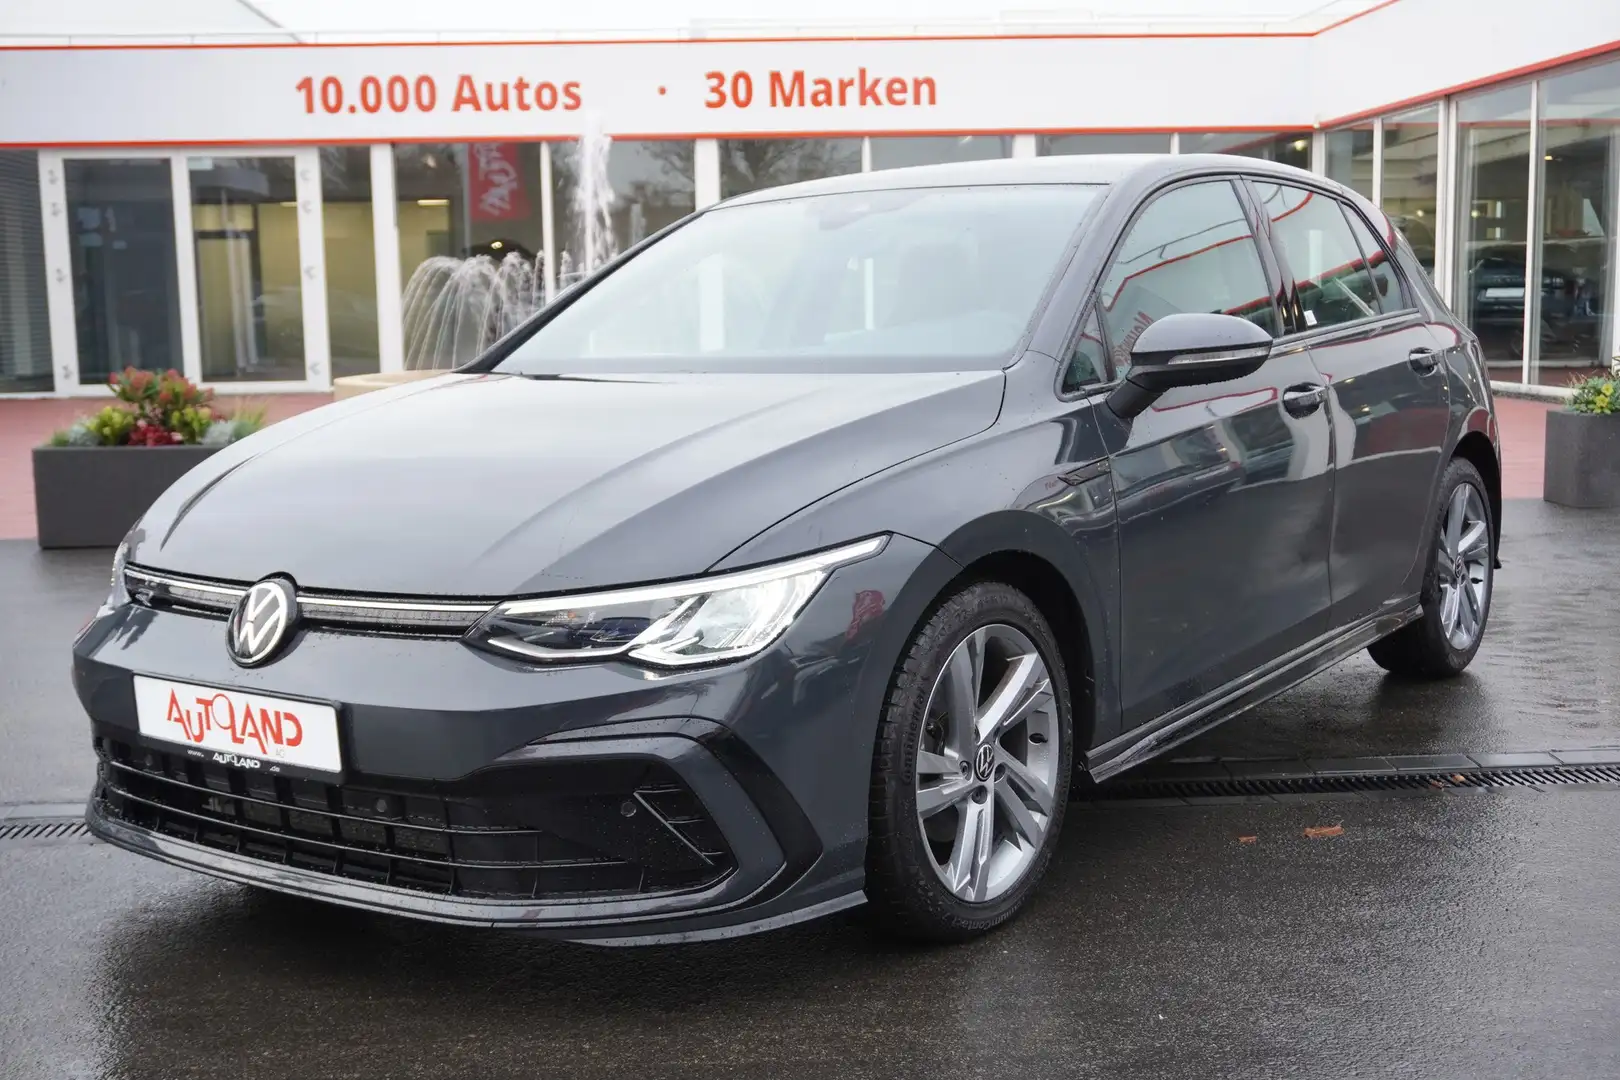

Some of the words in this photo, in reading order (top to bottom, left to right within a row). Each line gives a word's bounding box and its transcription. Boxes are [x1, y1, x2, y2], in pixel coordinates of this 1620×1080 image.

[295, 74, 437, 114] 10.000
[451, 74, 583, 112] Autos
[704, 70, 753, 109] 30
[768, 66, 937, 107] Marken
[166, 688, 303, 755] AUTOLAND
[212, 752, 262, 769] AUTOLAND
